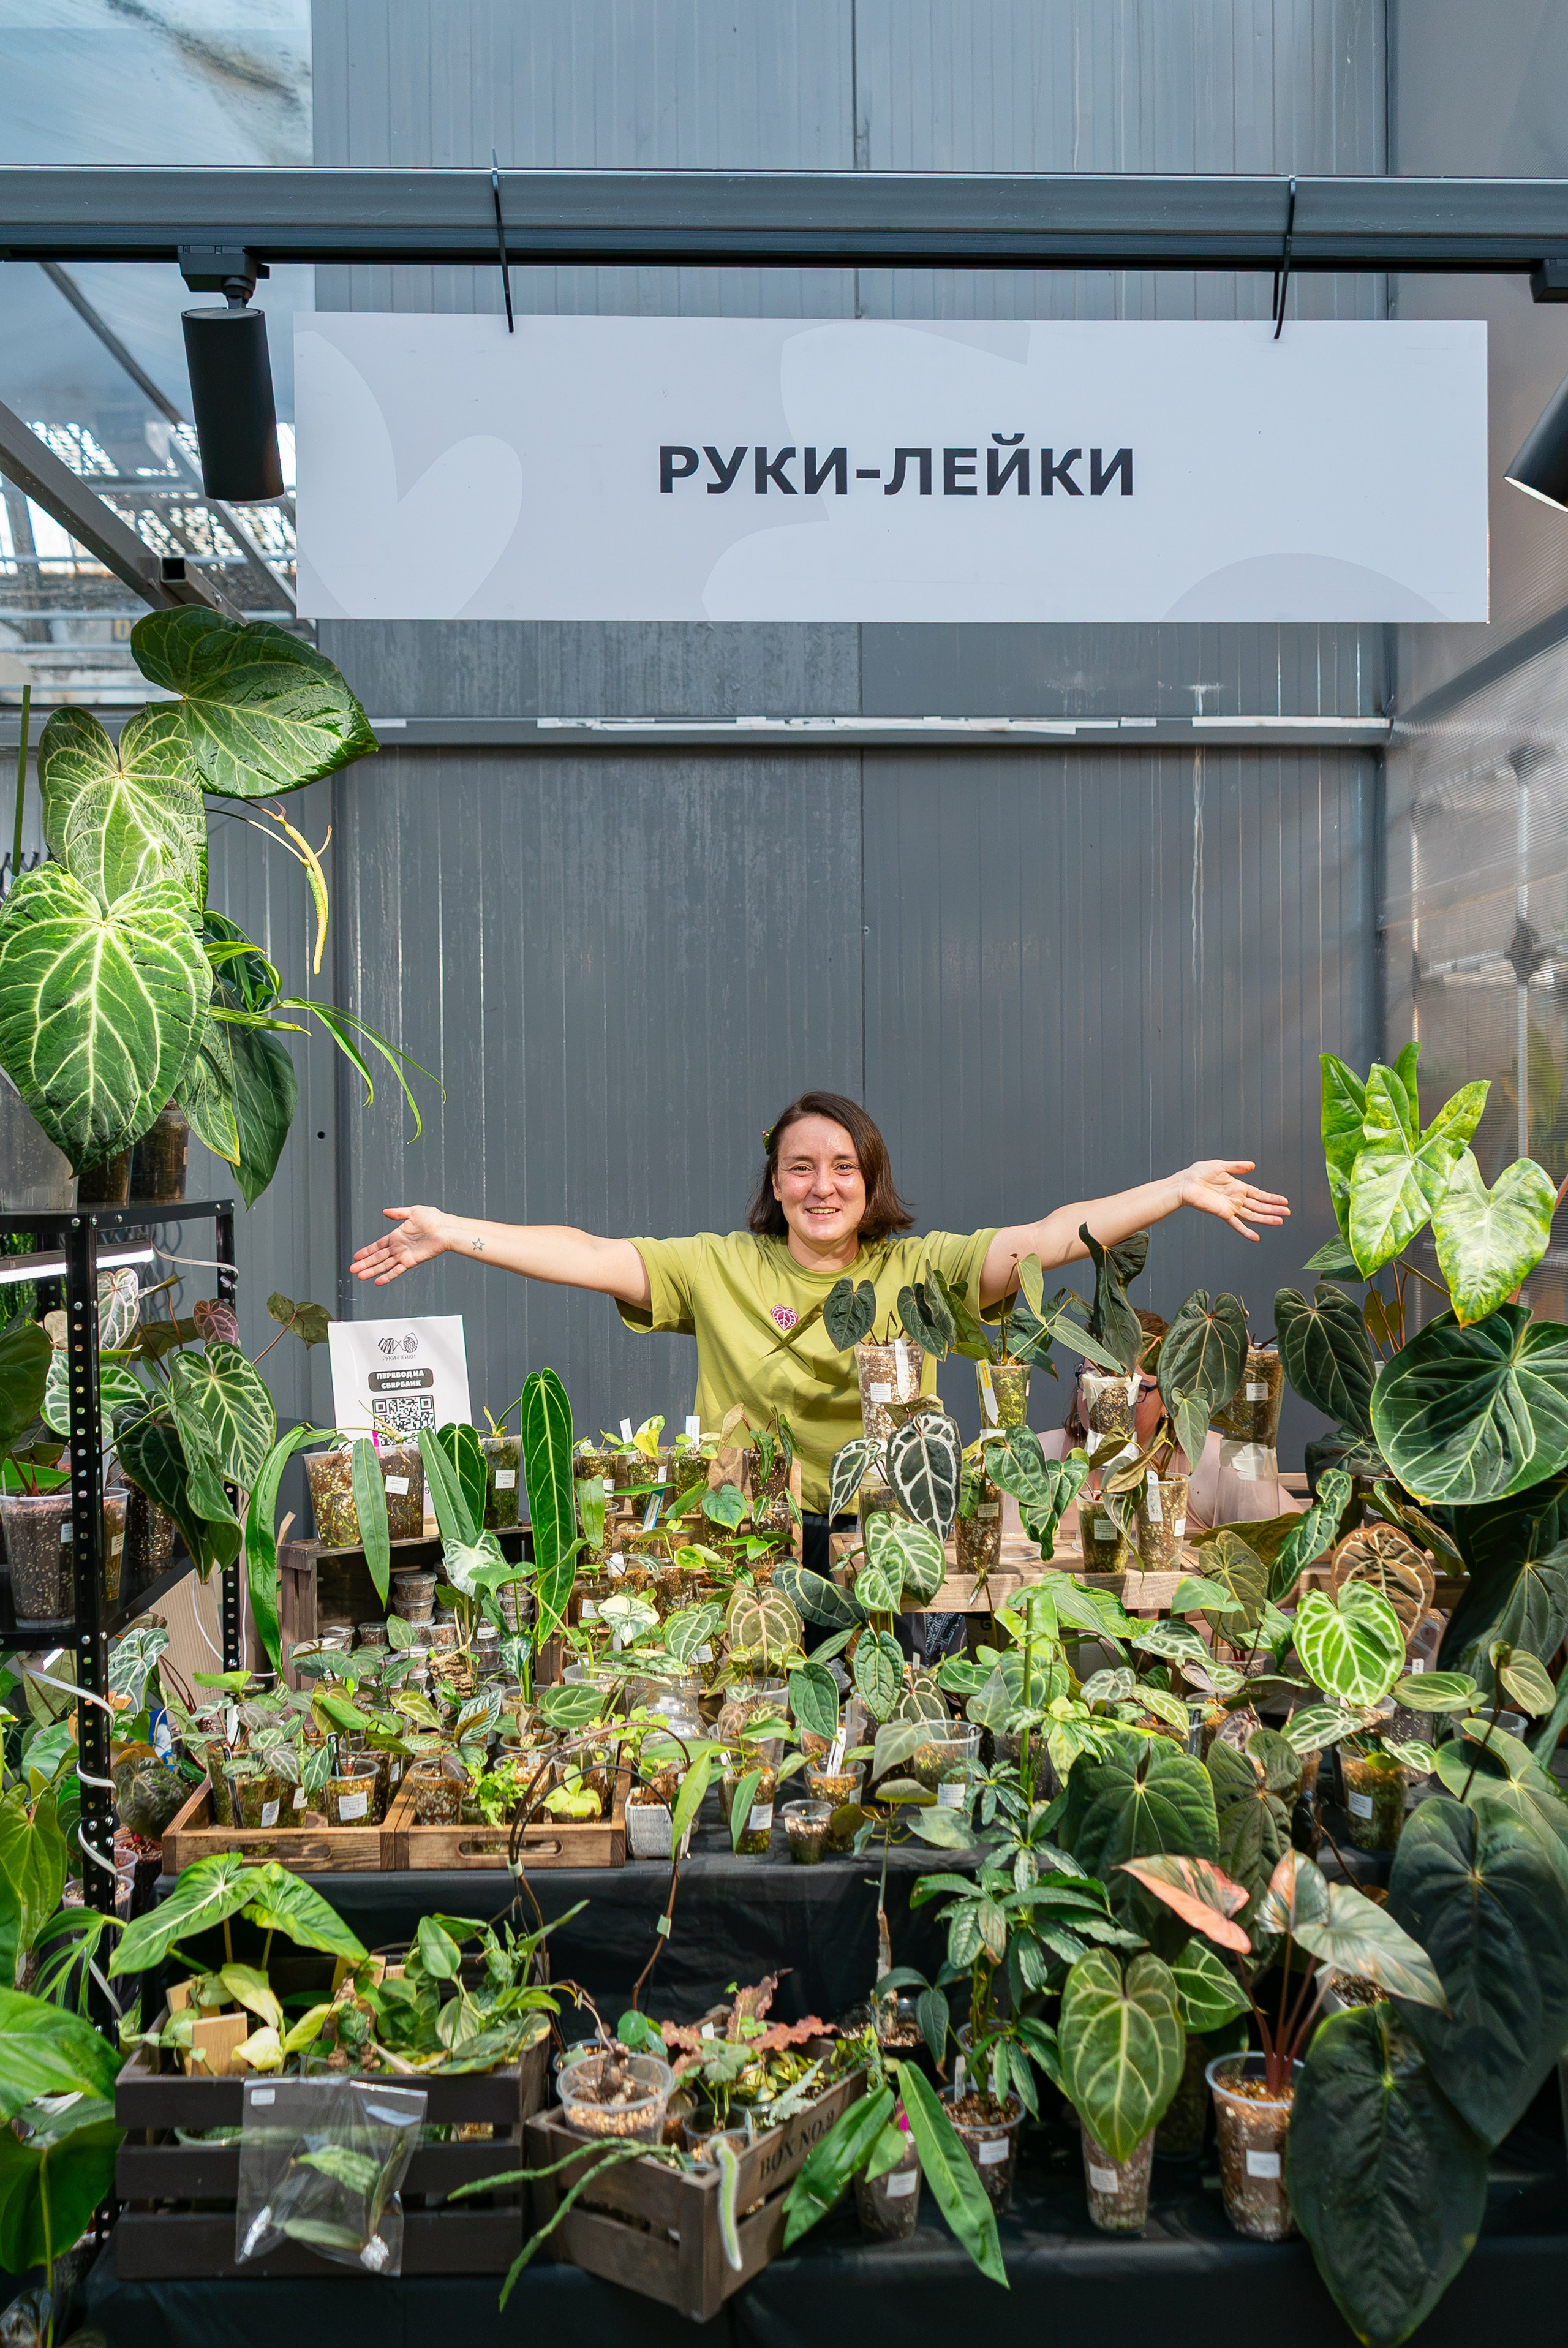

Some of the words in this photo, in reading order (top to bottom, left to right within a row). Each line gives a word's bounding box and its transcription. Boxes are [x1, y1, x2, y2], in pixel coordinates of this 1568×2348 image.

[660, 433, 1133, 495] РУКИ-ЛЕЙКИ
[376, 1370, 413, 1380] ПЕРЕВОД
[381, 1380, 421, 1389] СБЕРБАНК
[760, 2140, 794, 2180] BOX
